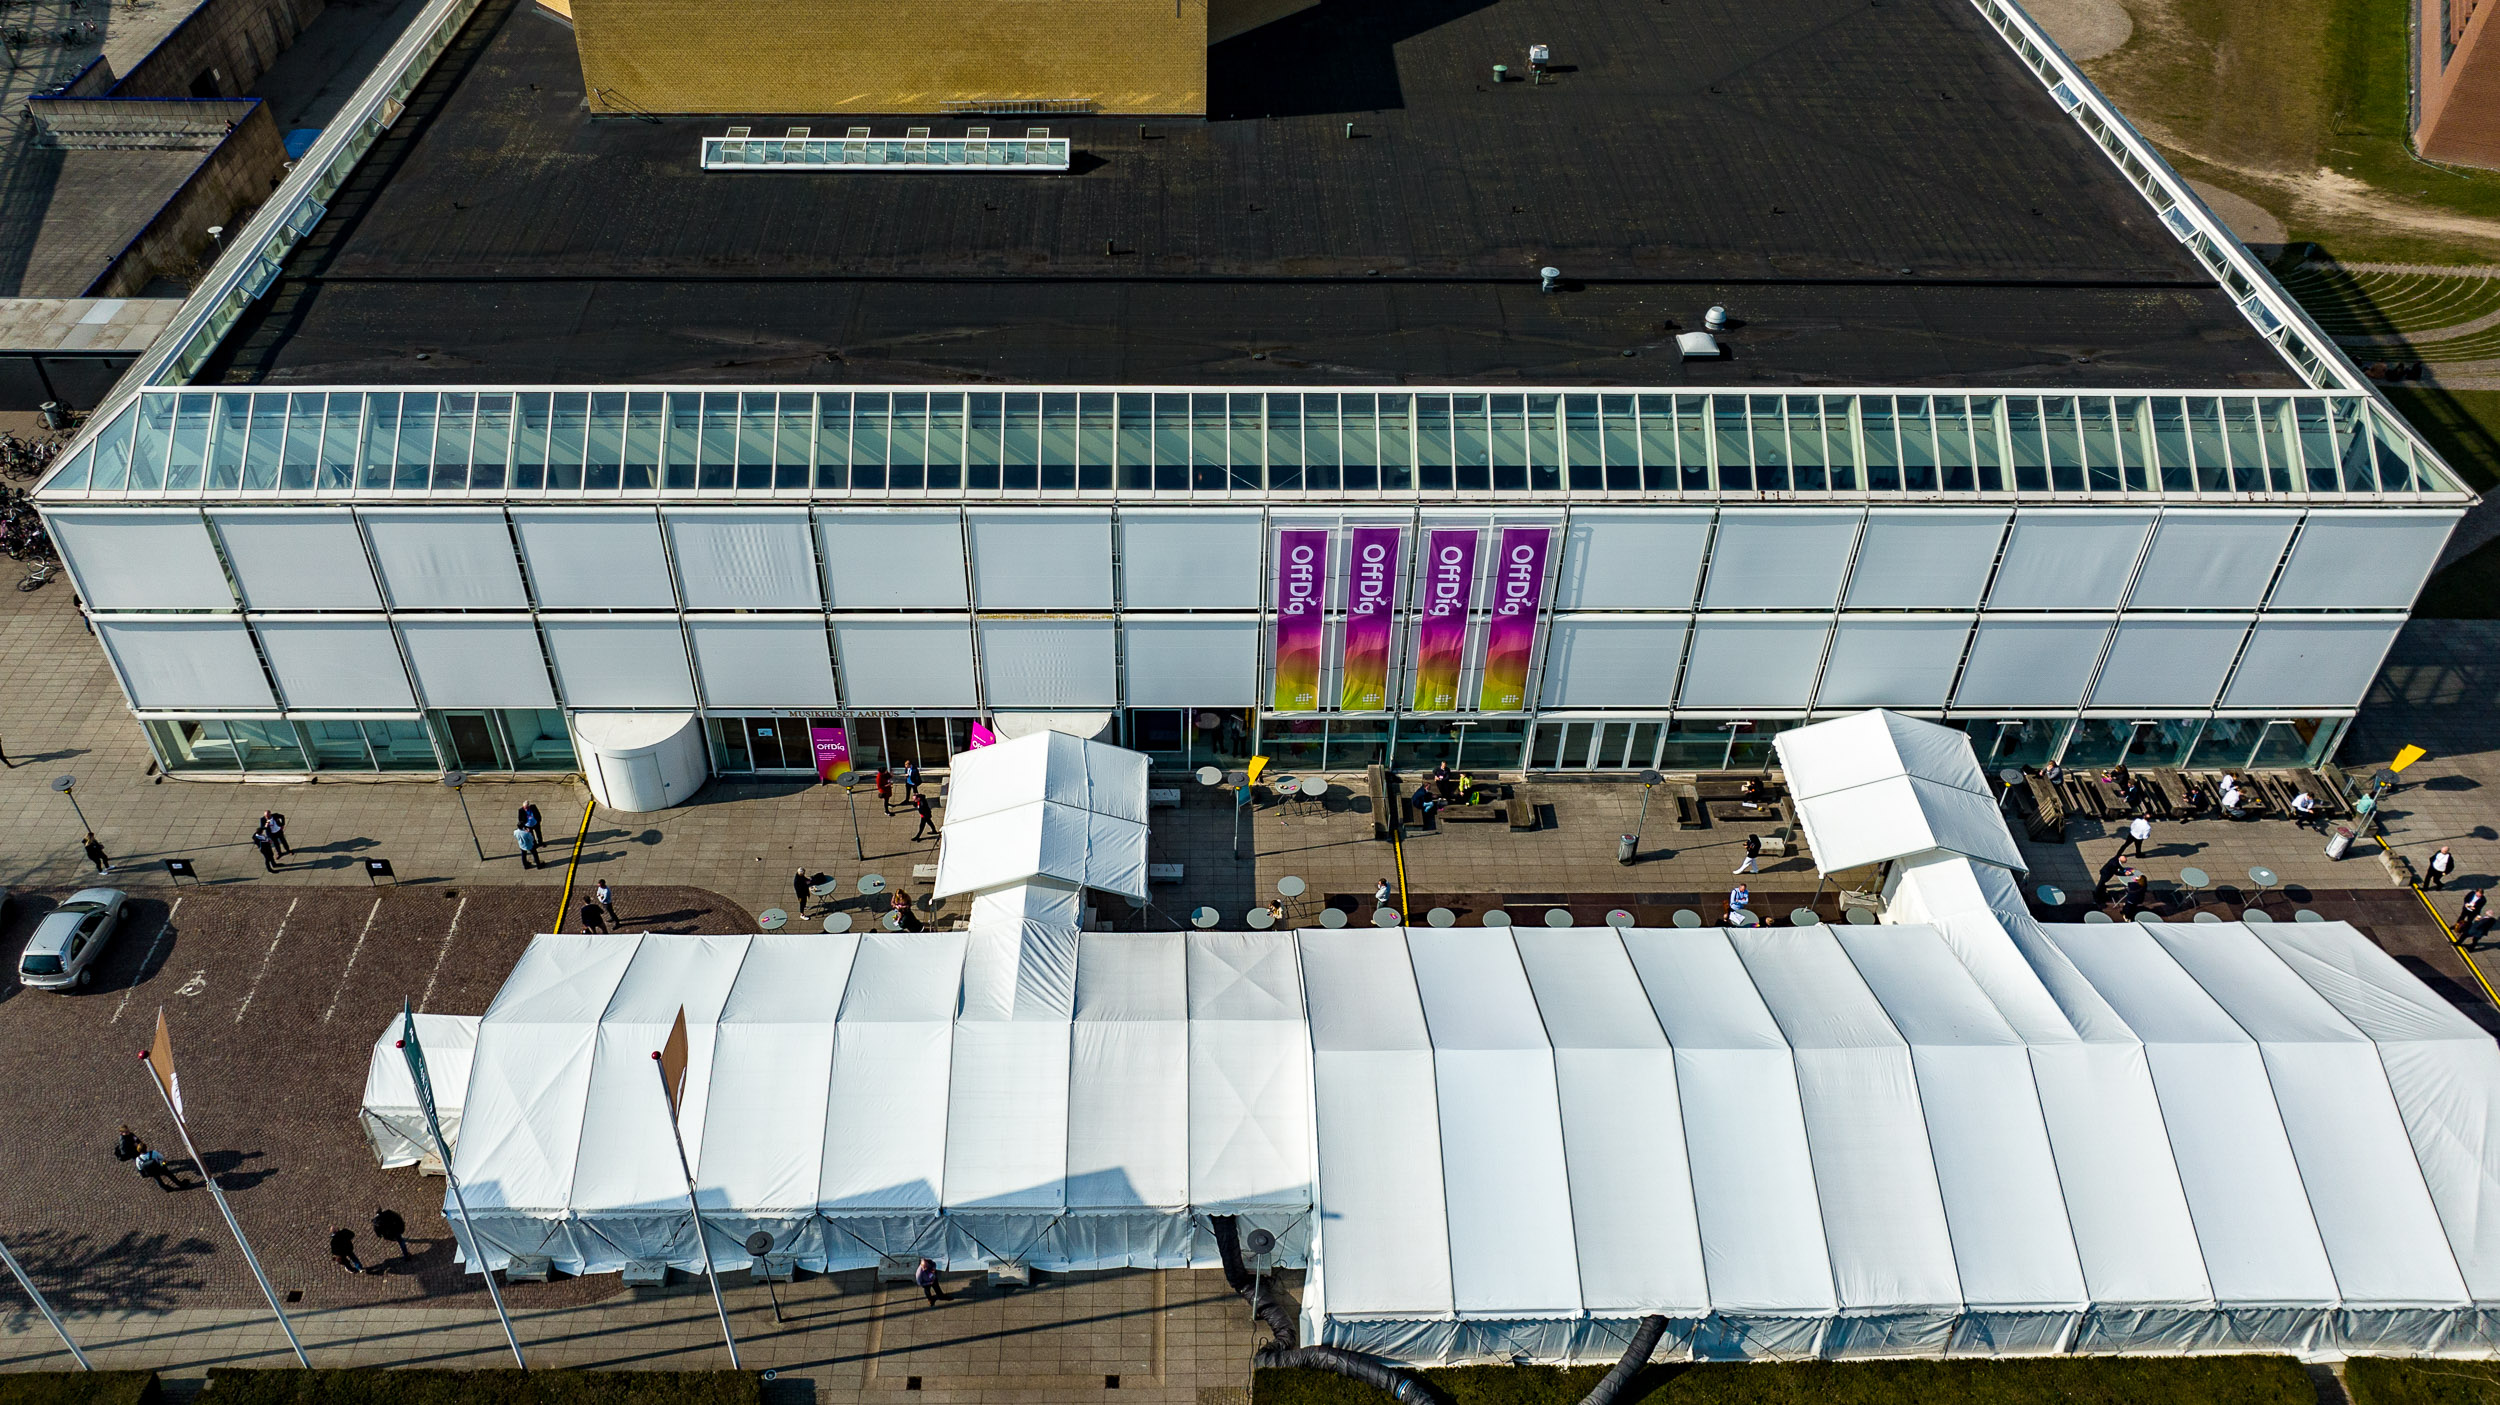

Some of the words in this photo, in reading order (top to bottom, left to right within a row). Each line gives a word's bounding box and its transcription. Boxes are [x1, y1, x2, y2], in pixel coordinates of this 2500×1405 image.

[1284, 545, 1318, 616] OffDig
[1353, 543, 1389, 615] OffDig
[1429, 545, 1463, 617] OffDig
[1498, 545, 1535, 616] OffDig
[788, 710, 855, 718] MUSIKHUSET
[857, 710, 900, 718] AARHUS
